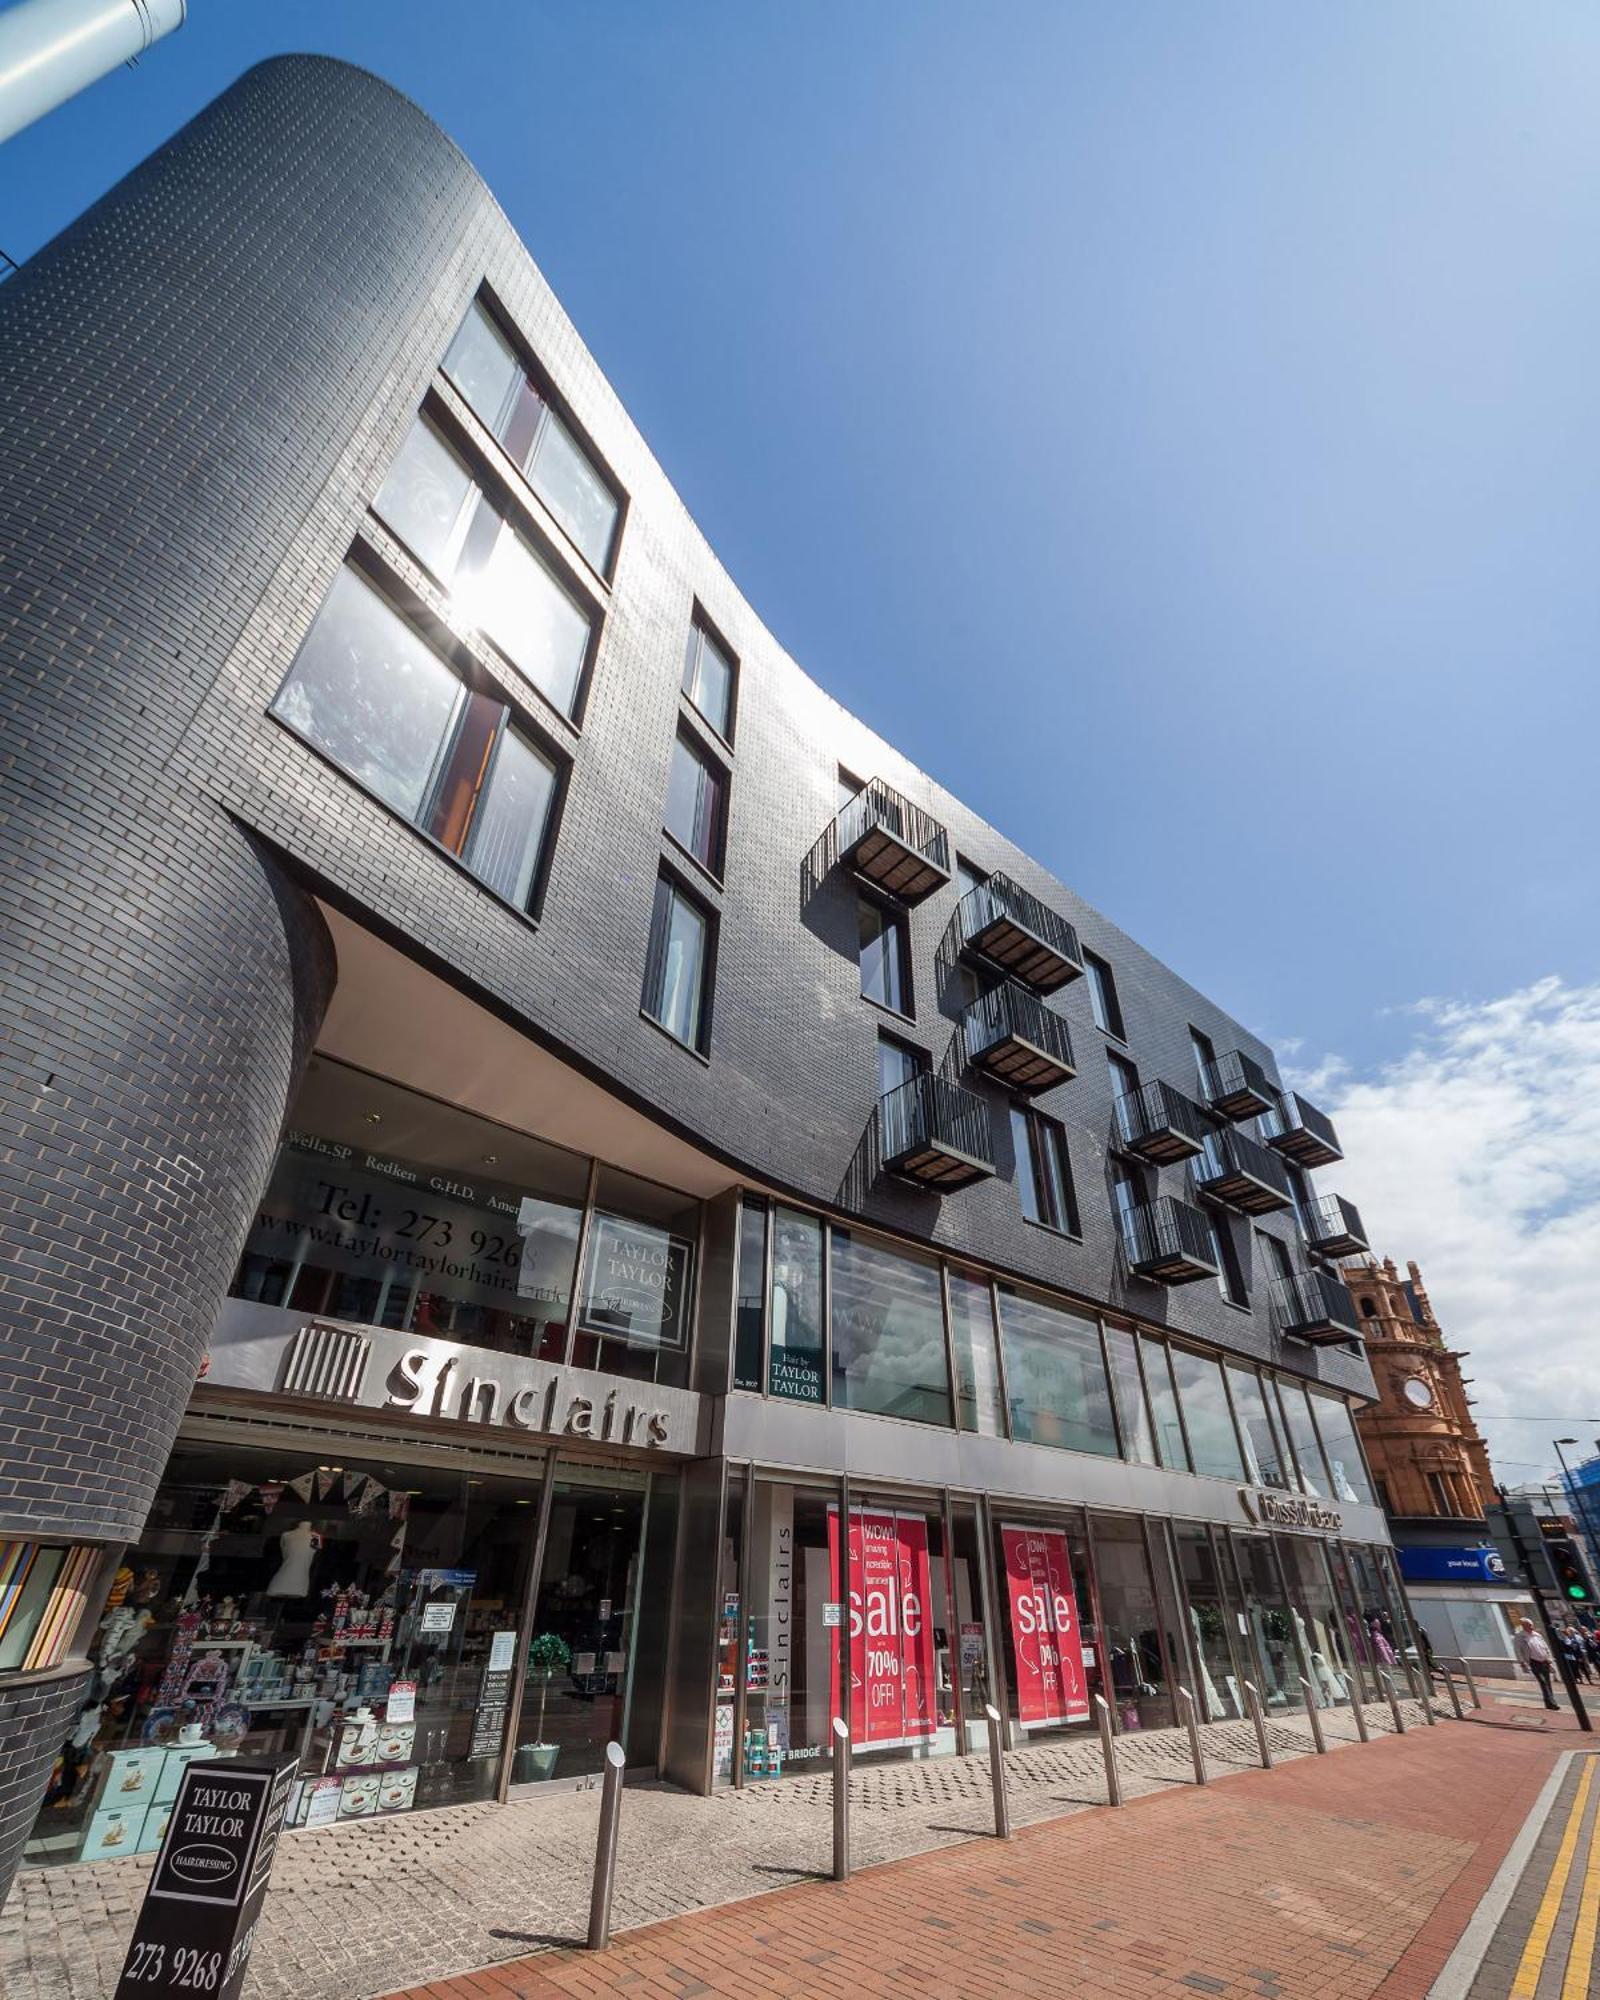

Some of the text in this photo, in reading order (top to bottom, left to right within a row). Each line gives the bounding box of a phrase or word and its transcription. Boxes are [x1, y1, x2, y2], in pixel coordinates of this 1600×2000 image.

[366, 1155, 417, 1183] Redken
[486, 1195, 521, 1215] Amer
[318, 1181, 381, 1229] Tel:
[395, 1209, 453, 1248] 273
[611, 1239, 675, 1271] TAYLOR
[608, 1259, 672, 1292] TAYLOR
[771, 1379, 818, 1398] TAYLOR
[772, 1363, 819, 1383] TAYLOR
[387, 1348, 671, 1445] Sinclairs
[774, 1527, 790, 1686] Sinclairs
[849, 1576, 921, 1637] sale
[1017, 1582, 1071, 1634] sale
[868, 1651, 898, 1677] 70%
[872, 1684, 895, 1707] OFF!
[788, 1746, 821, 1760] BRIDGE
[192, 1786, 251, 1811] TAYLOR
[184, 1812, 244, 1838] TAYLOR
[175, 1855, 232, 1871] HAIRDRESSING
[125, 1941, 166, 1982] 273
[168, 1947, 221, 1990] 9268
